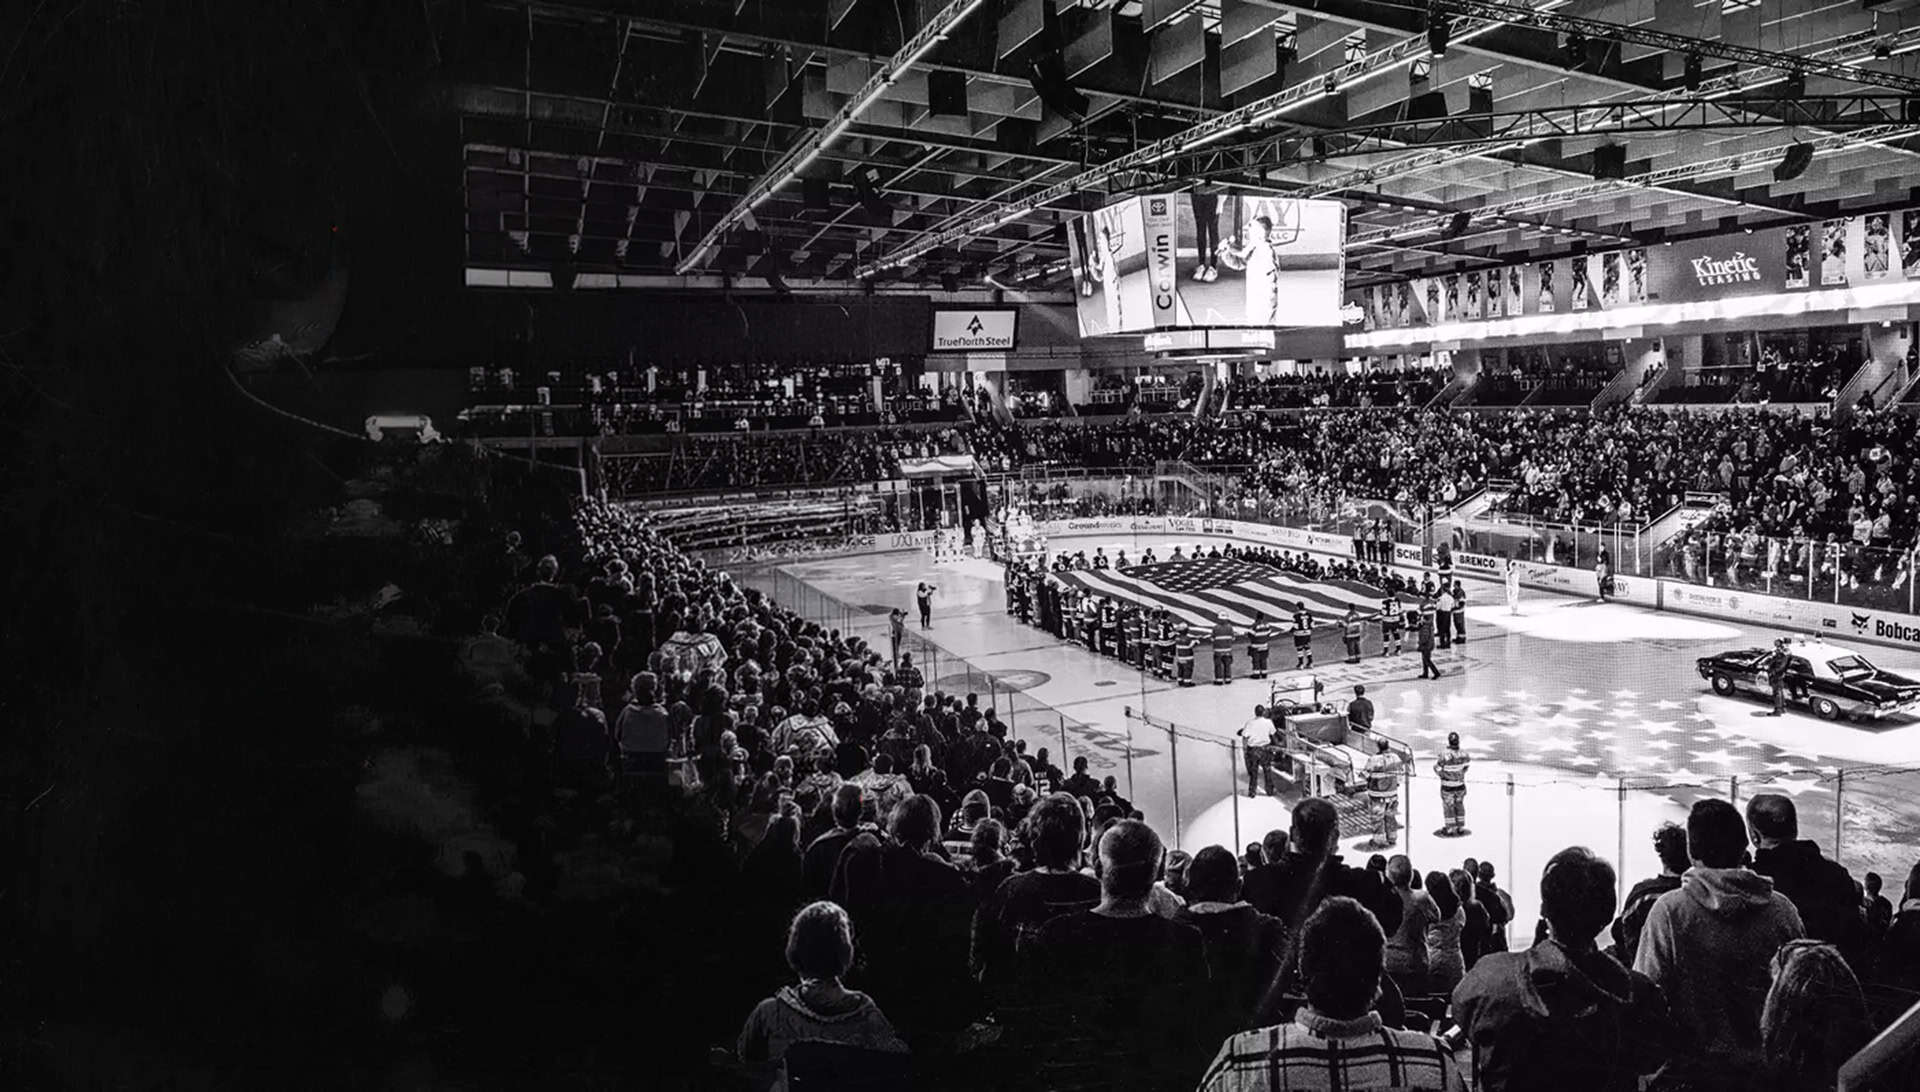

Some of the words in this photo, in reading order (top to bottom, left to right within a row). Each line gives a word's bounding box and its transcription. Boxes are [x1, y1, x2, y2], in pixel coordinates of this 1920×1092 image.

[1153, 235, 1172, 309] Cowin
[1691, 252, 1759, 278] Kinetic
[1459, 555, 1496, 568] BRENCO
